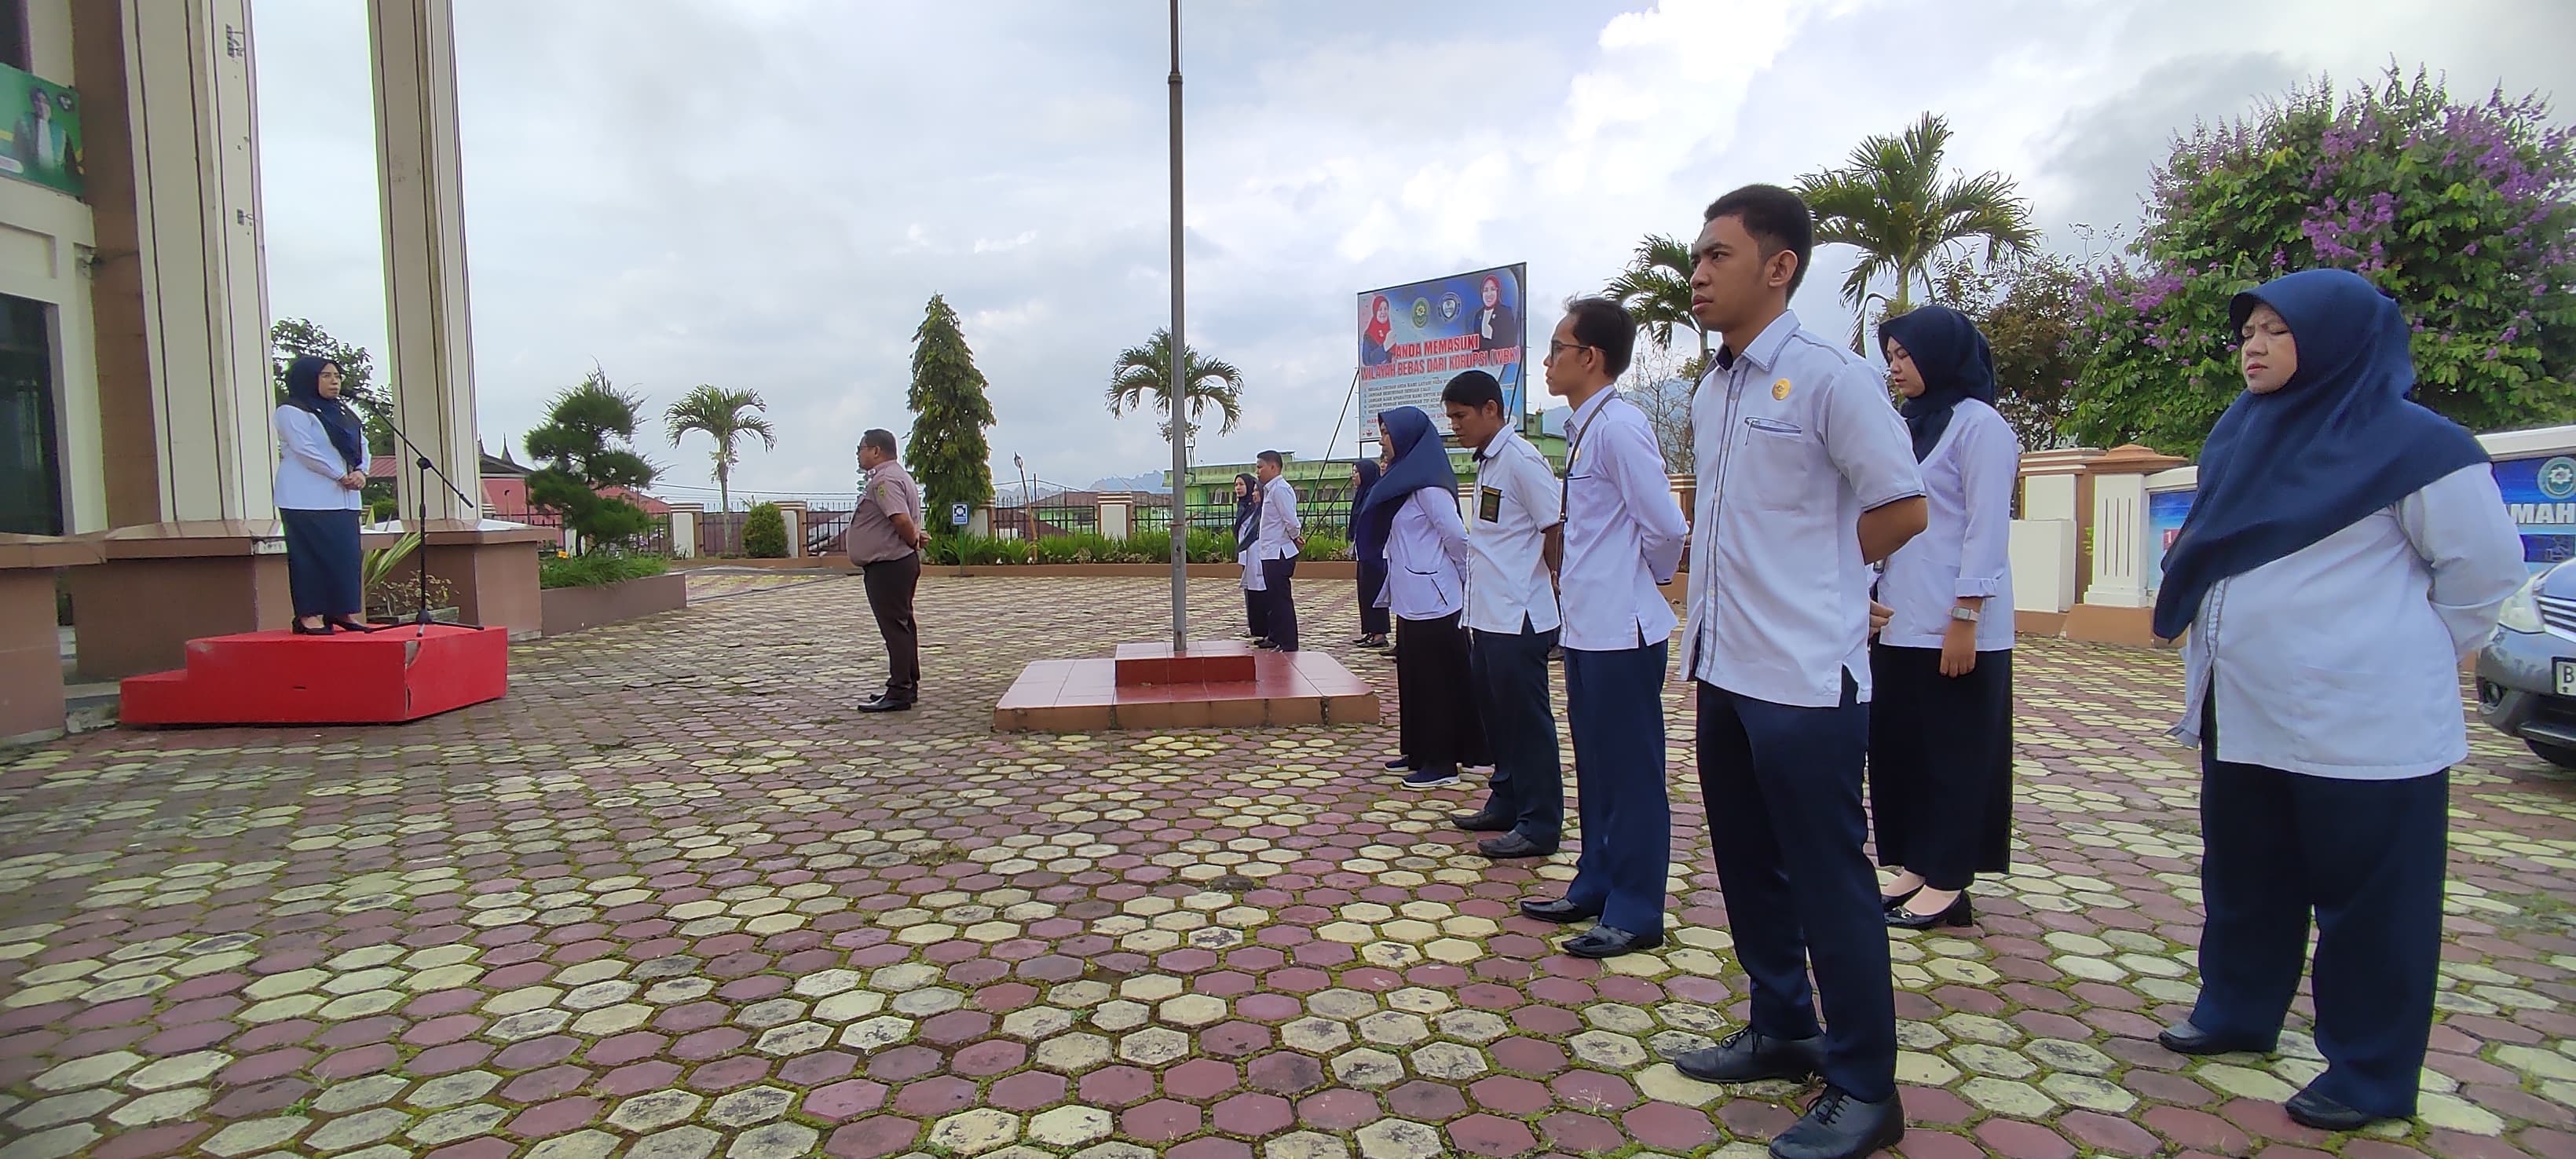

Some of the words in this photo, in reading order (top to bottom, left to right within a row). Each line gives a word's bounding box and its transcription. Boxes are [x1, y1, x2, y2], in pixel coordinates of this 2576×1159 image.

[1396, 342, 1421, 359] ANDA
[1425, 335, 1479, 356] MEMASUKI
[1361, 363, 1396, 380] WILAYAH
[1398, 359, 1425, 375] BEBAS
[1428, 356, 1447, 372] DARI
[1450, 351, 1488, 369] KORUPSI
[1490, 346, 1520, 366] (WBK)
